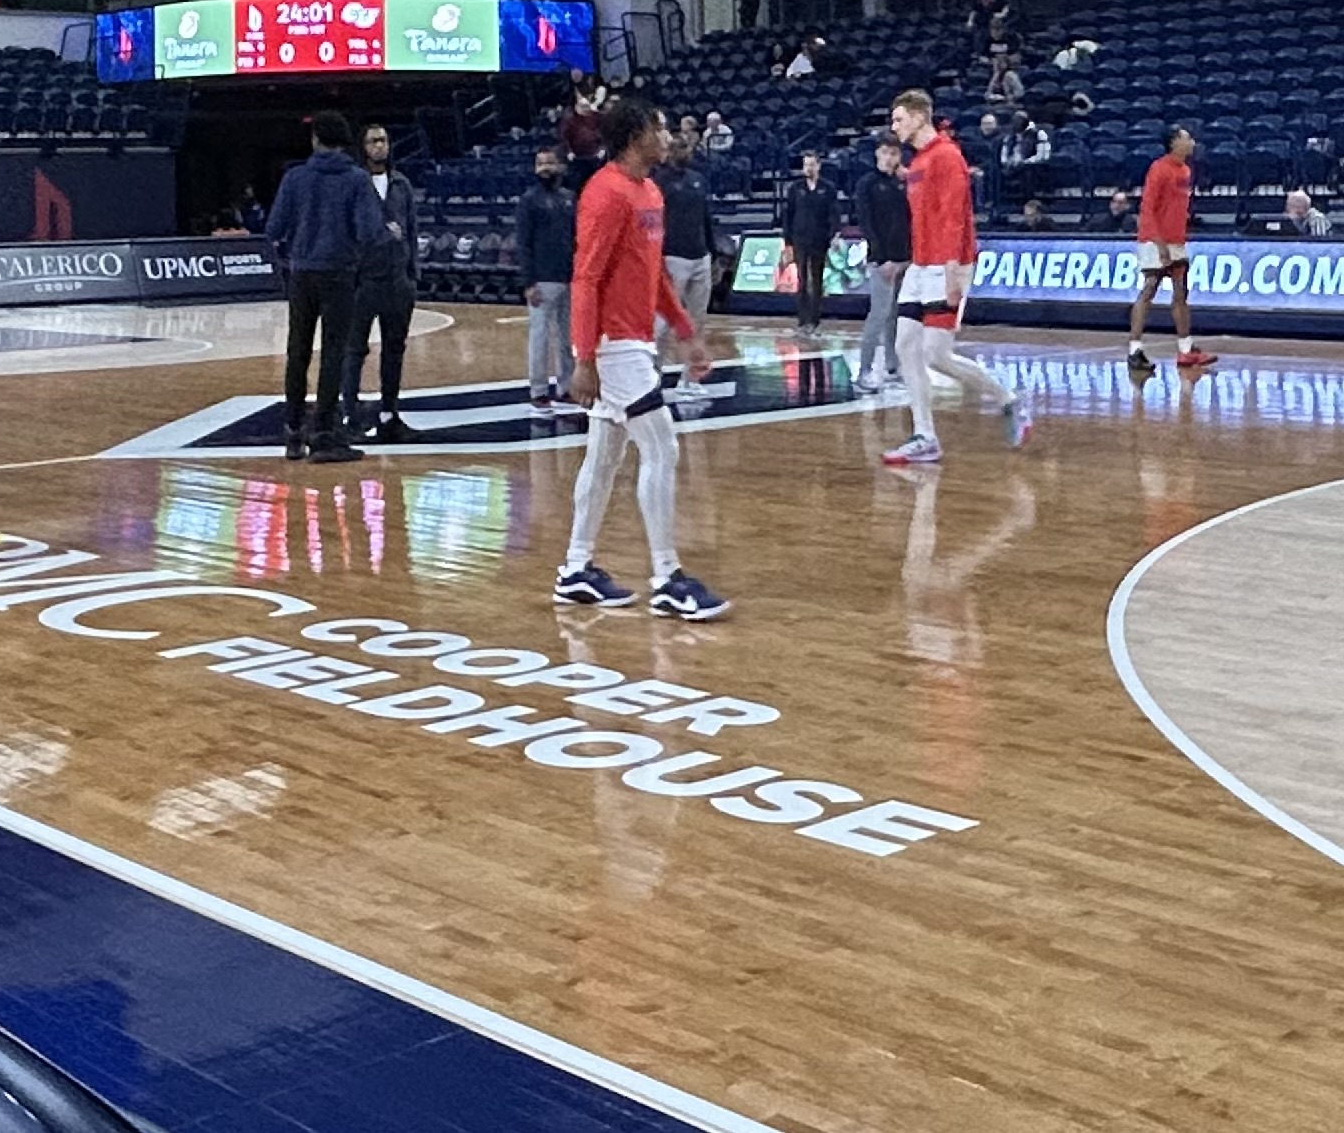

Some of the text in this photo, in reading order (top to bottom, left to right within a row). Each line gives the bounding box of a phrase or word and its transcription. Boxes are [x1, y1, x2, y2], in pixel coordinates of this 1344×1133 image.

[276, 1, 334, 24] 24:01
[279, 41, 296, 64] 0
[318, 40, 336, 63] 0
[403, 29, 482, 53] Panera
[143, 255, 219, 279] UPMC
[34, 282, 83, 293] GROUP
[300, 618, 781, 736] COOPER
[156, 635, 980, 857] FIELDHOUSE
